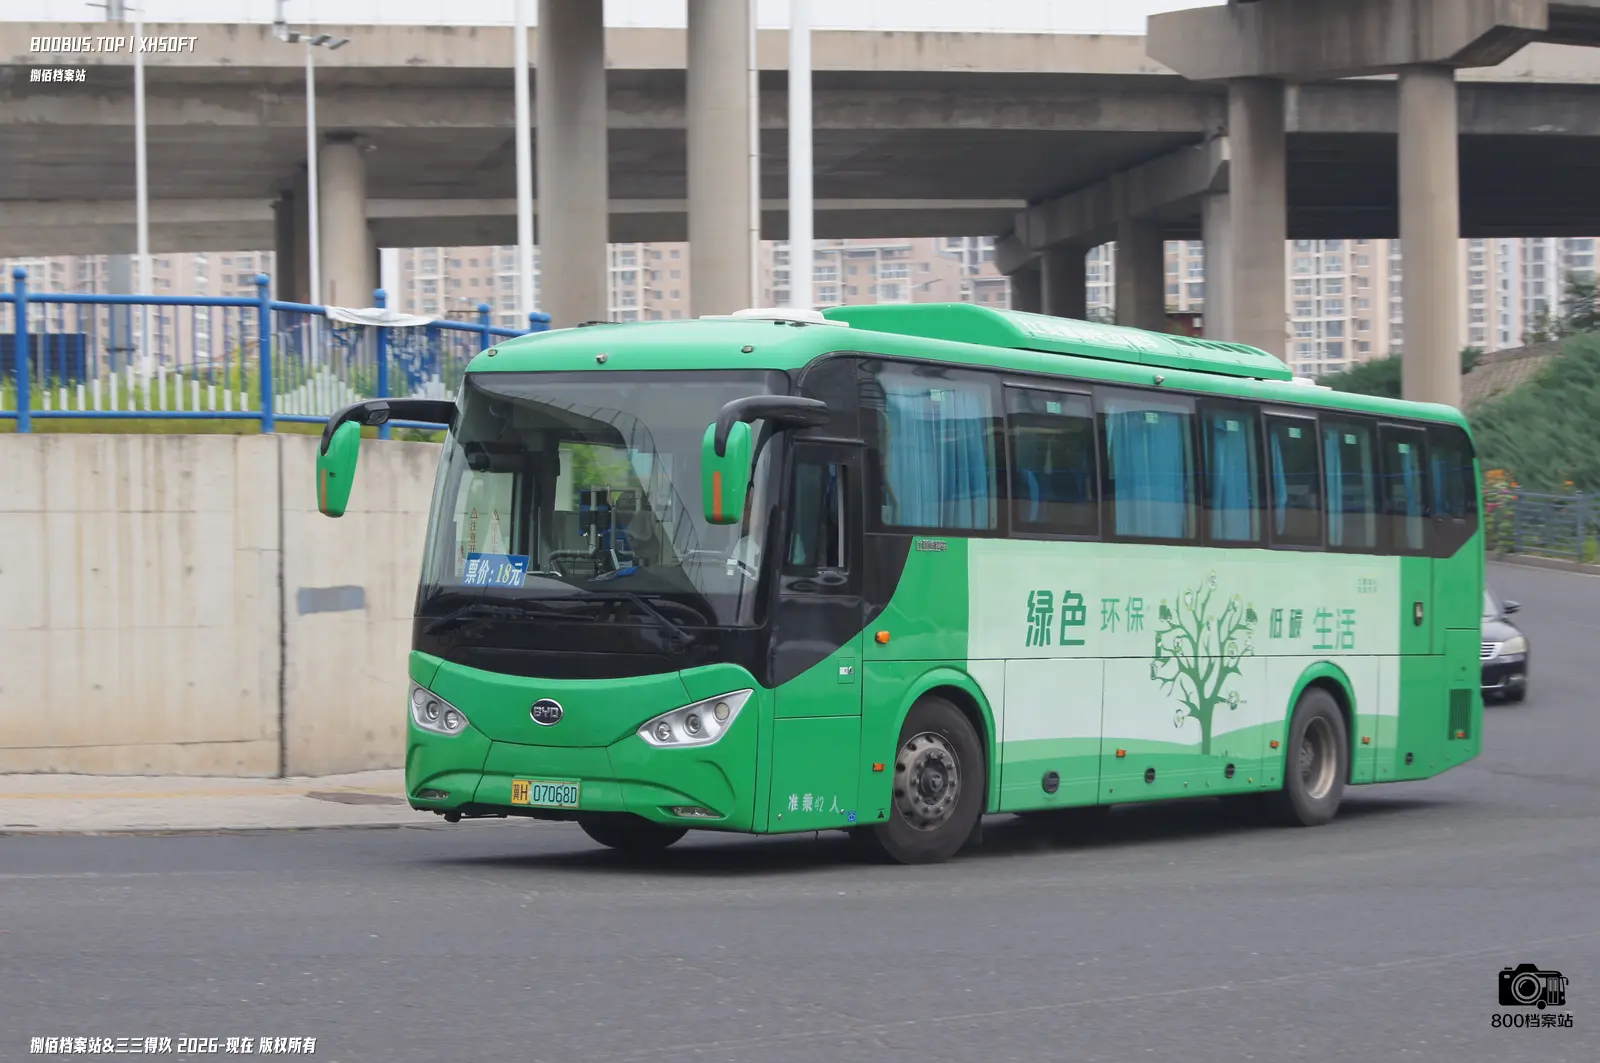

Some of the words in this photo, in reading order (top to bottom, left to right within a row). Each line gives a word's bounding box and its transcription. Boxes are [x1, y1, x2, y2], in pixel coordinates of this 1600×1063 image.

[1025, 589, 1087, 648] 绿色
[1100, 596, 1144, 634] 环保
[1269, 607, 1304, 639] 低碳
[1312, 606, 1357, 650] 生活
[533, 706, 559, 719] BYD
